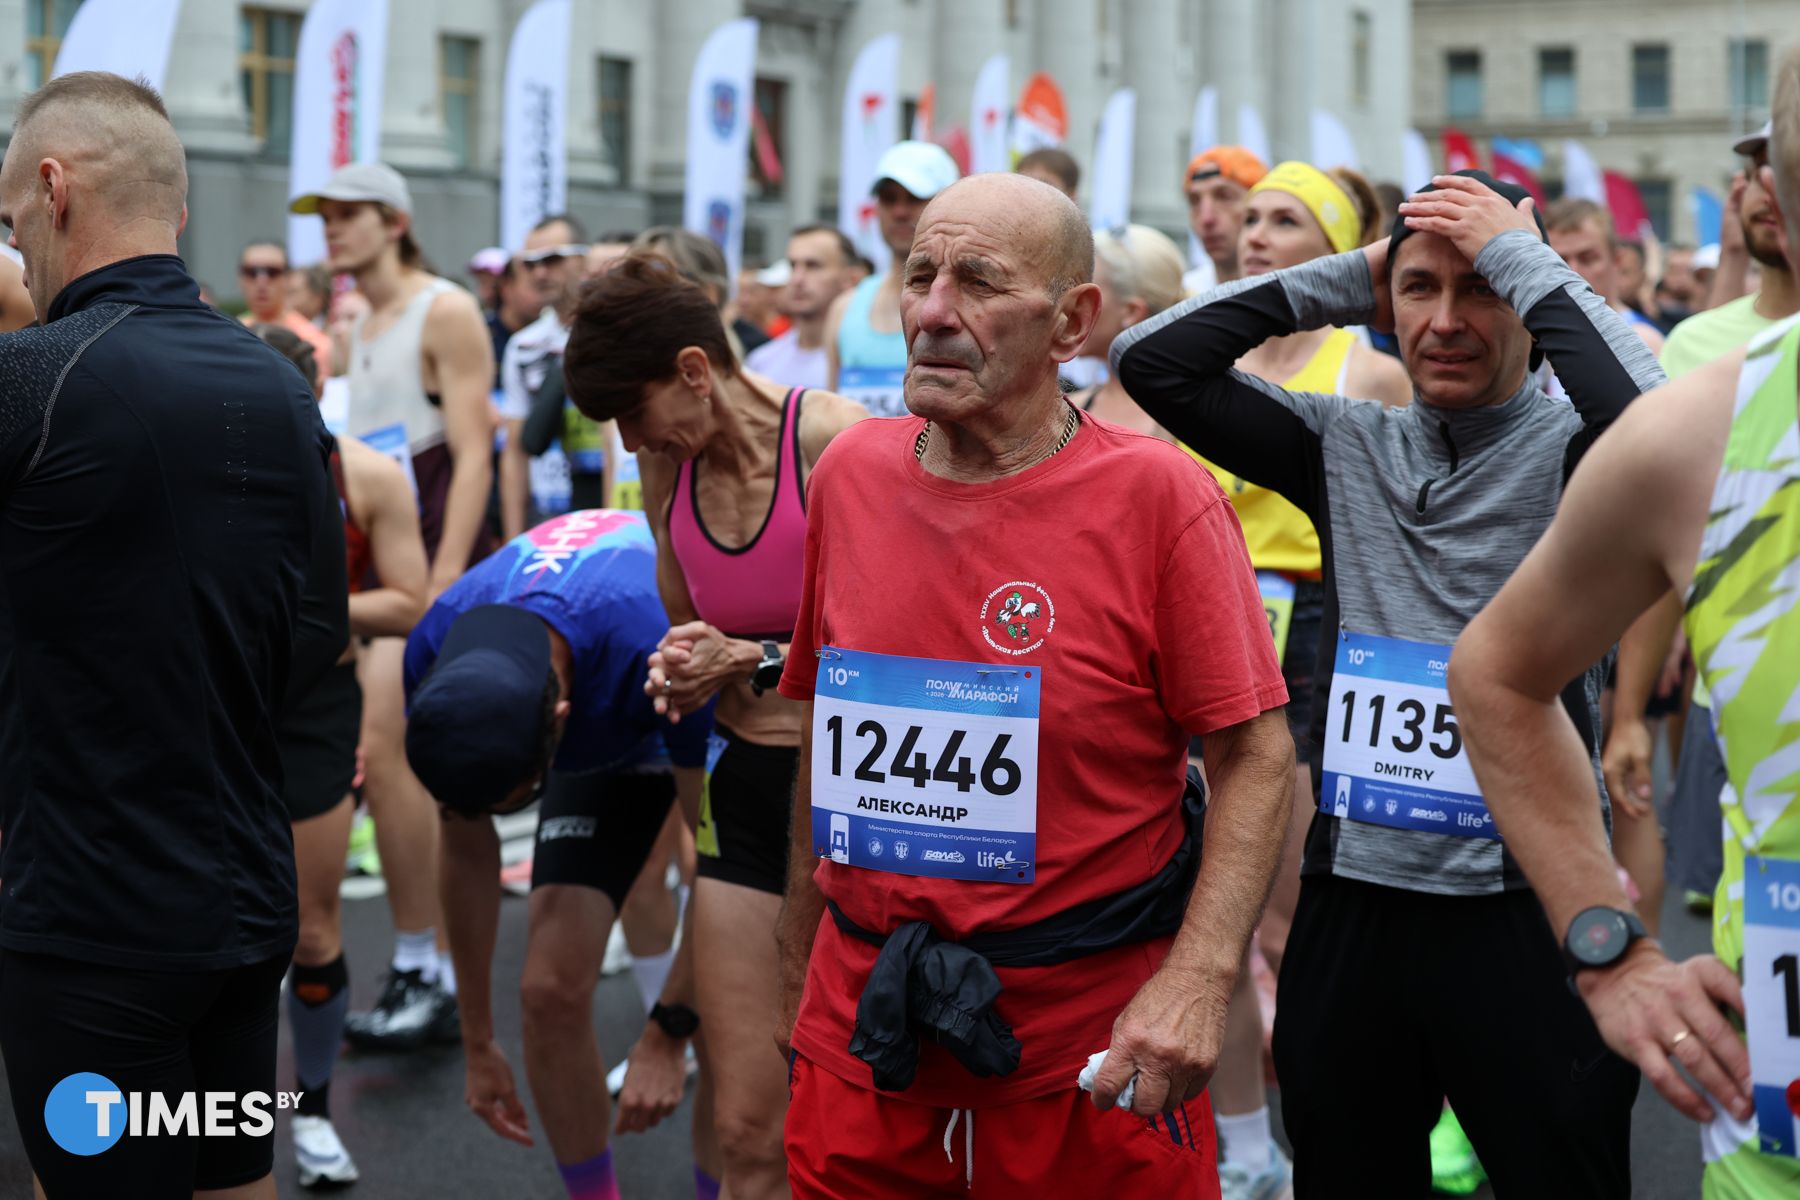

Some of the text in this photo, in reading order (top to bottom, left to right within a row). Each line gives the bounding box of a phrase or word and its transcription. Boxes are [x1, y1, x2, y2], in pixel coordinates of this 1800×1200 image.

[988, 581, 1037, 599] Национальный
[1036, 586, 1055, 616] фестиваль
[950, 689, 1019, 704] МАРАФОН
[1342, 690, 1463, 759] 1135
[826, 715, 1022, 797] 12446
[1374, 761, 1435, 782] DMITRY
[856, 796, 969, 823] АЛЕКСАНДР
[1457, 811, 1483, 828] life
[867, 823, 913, 836] Министерство
[914, 830, 938, 839] спорта
[939, 832, 981, 843] Республики
[977, 851, 1006, 868] life
